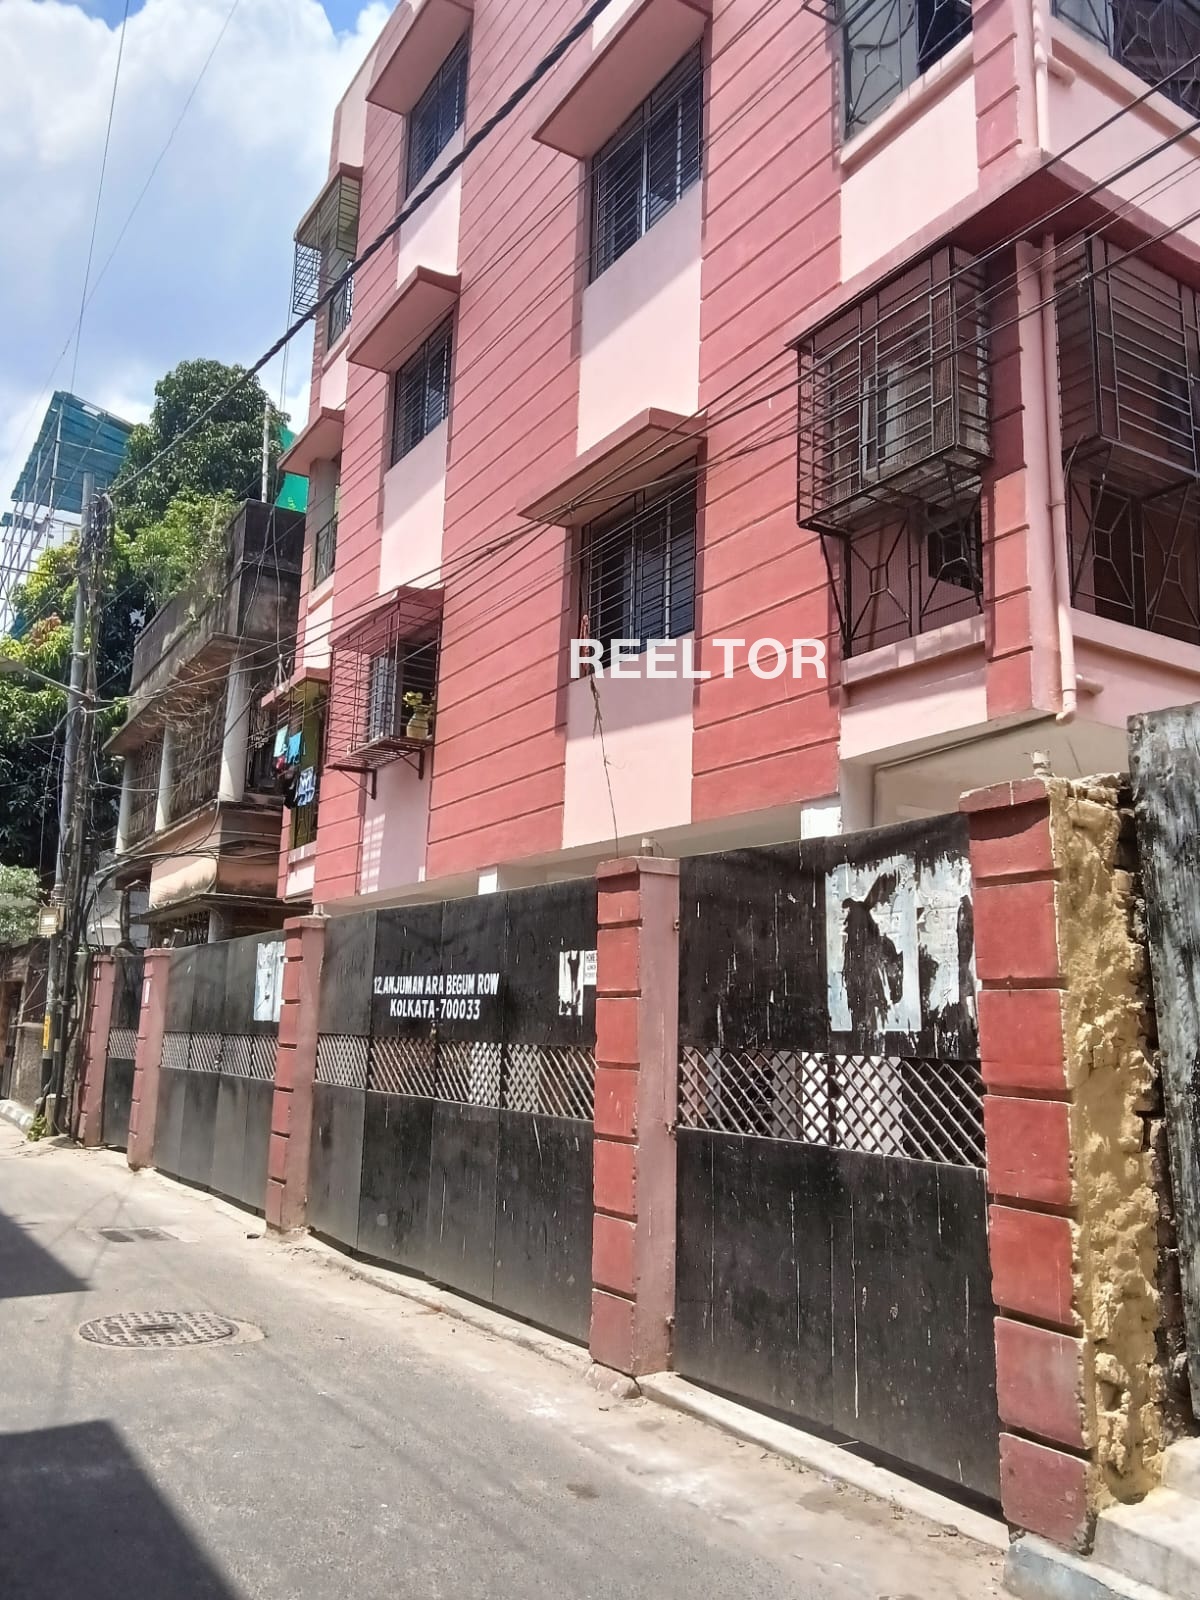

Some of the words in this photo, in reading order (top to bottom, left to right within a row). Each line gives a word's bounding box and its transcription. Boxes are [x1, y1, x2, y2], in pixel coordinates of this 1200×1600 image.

[424, 975, 444, 995] ARA
[446, 973, 475, 995] BEGUM
[477, 972, 500, 995] ROW
[390, 998, 481, 1020] KOLKATA-700033
